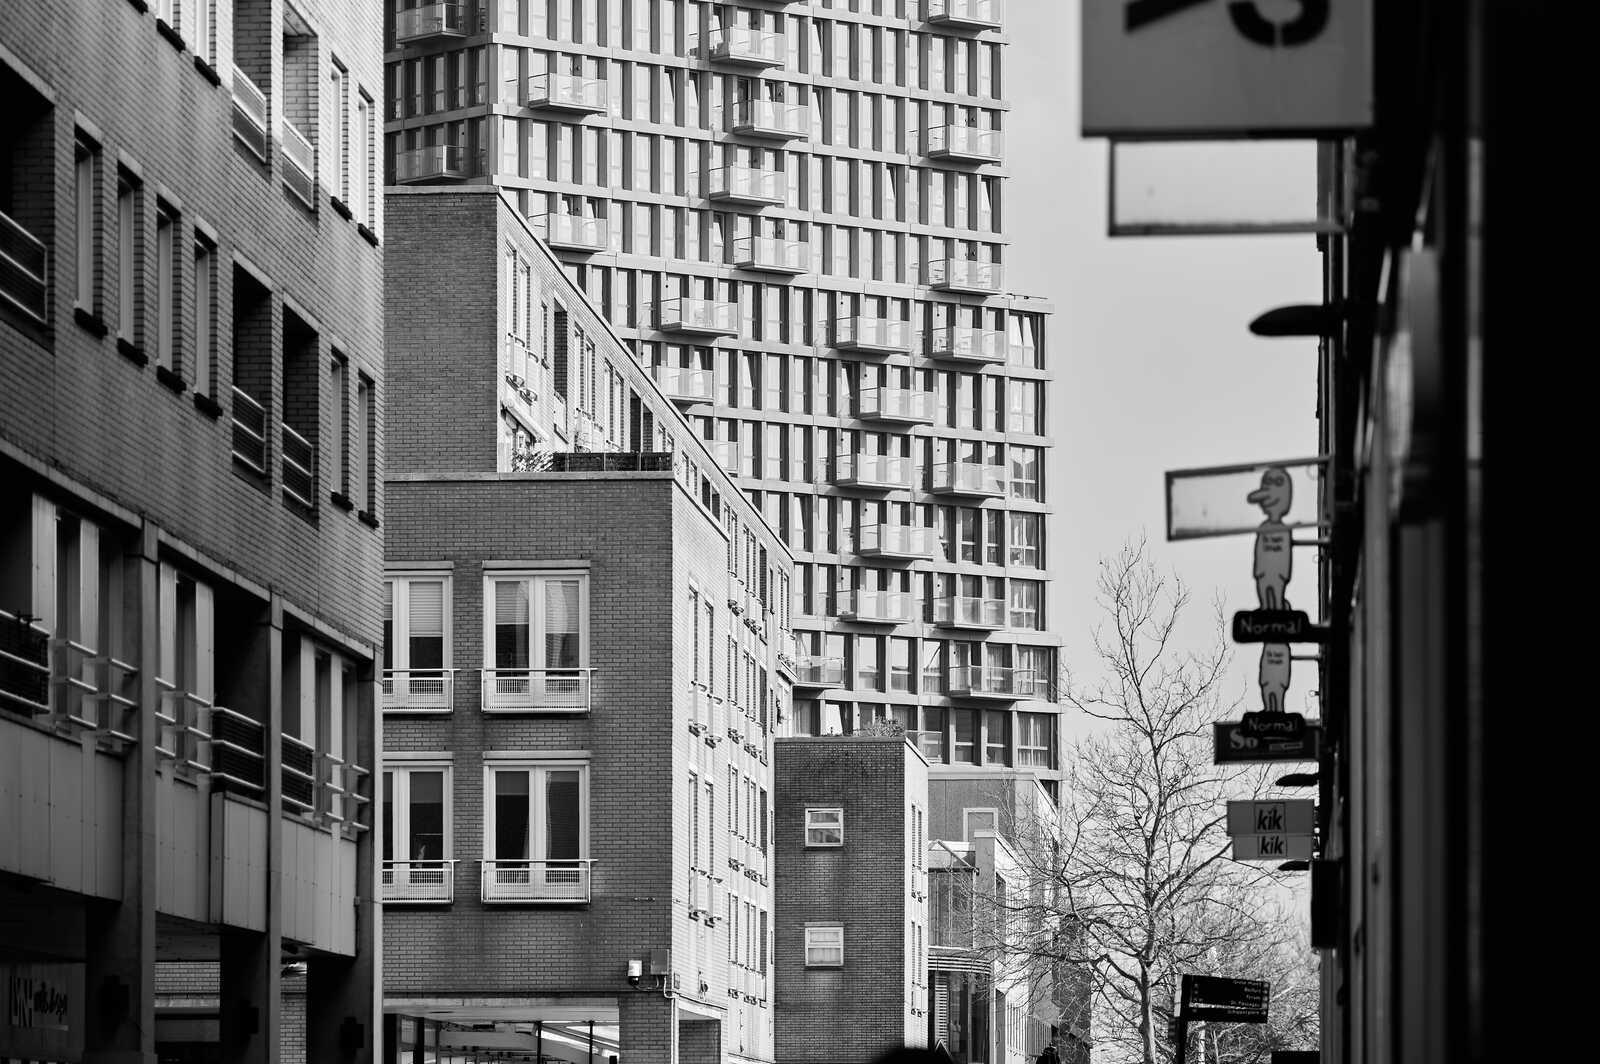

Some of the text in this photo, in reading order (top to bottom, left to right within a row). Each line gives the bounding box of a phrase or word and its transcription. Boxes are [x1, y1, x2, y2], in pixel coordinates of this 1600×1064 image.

[1241, 616, 1302, 634] Normal
[1248, 717, 1298, 732] Normal
[1257, 807, 1283, 830] kik
[1261, 835, 1284, 855] kik
